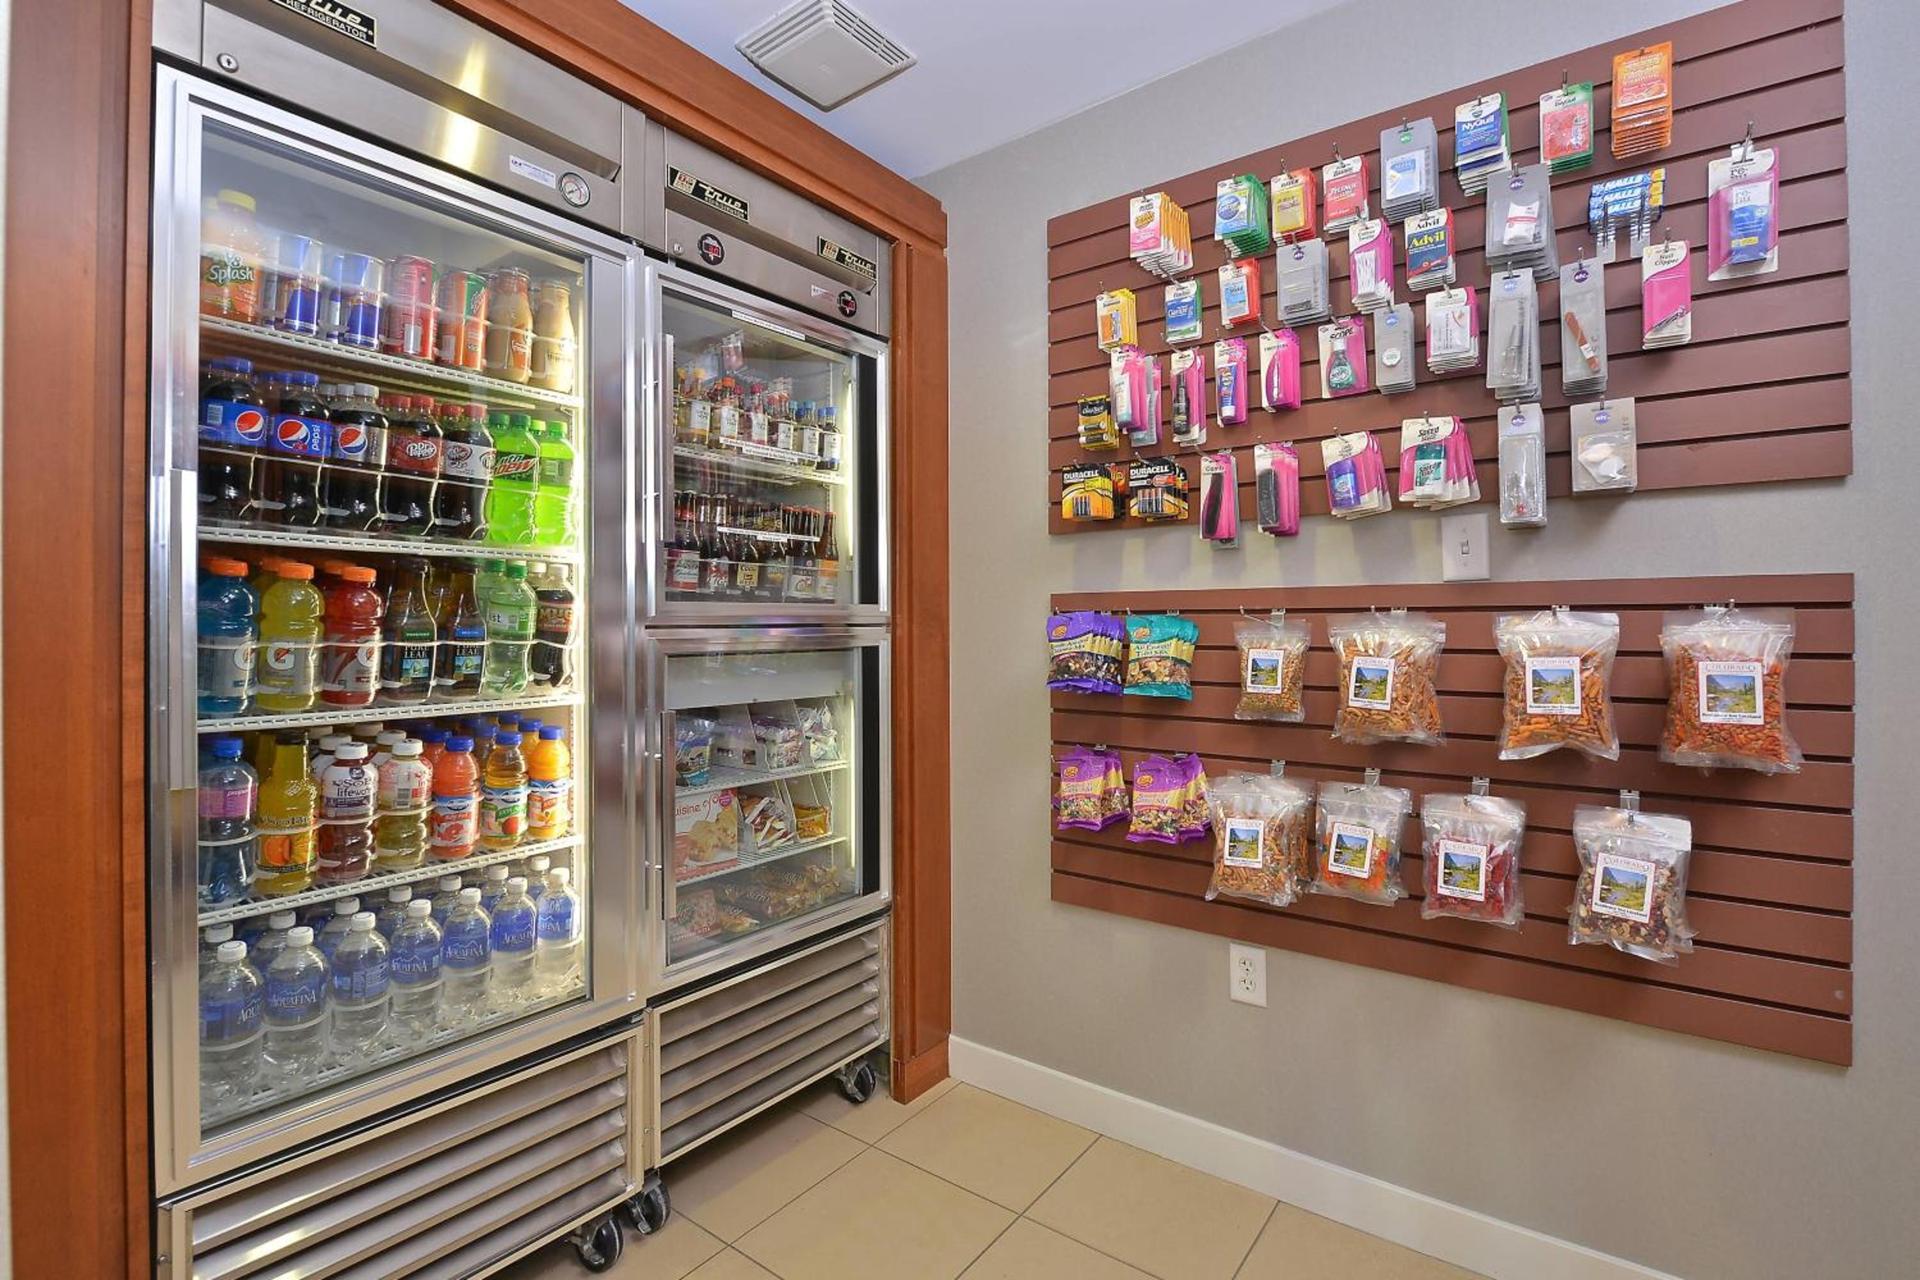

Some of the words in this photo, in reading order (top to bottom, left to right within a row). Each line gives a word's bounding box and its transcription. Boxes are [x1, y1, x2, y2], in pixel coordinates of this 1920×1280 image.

[286, 0, 367, 40] REFRIGERATOR
[1461, 114, 1495, 131] NyQuil
[1605, 173, 1645, 190] HALLS
[1416, 218, 1440, 230] Advil
[1409, 231, 1446, 248] Advil
[224, 252, 242, 267] V8
[208, 264, 255, 288] Splash
[311, 424, 322, 452] pepsi
[1064, 470, 1099, 480] DURACELL
[1130, 465, 1160, 476] DURACELL
[267, 641, 296, 671] G
[404, 650, 428, 659] LEAF
[1705, 663, 1757, 671] COLORADO
[1603, 857, 1649, 872] COLORADO
[272, 989, 317, 1008] AQUAFINA
